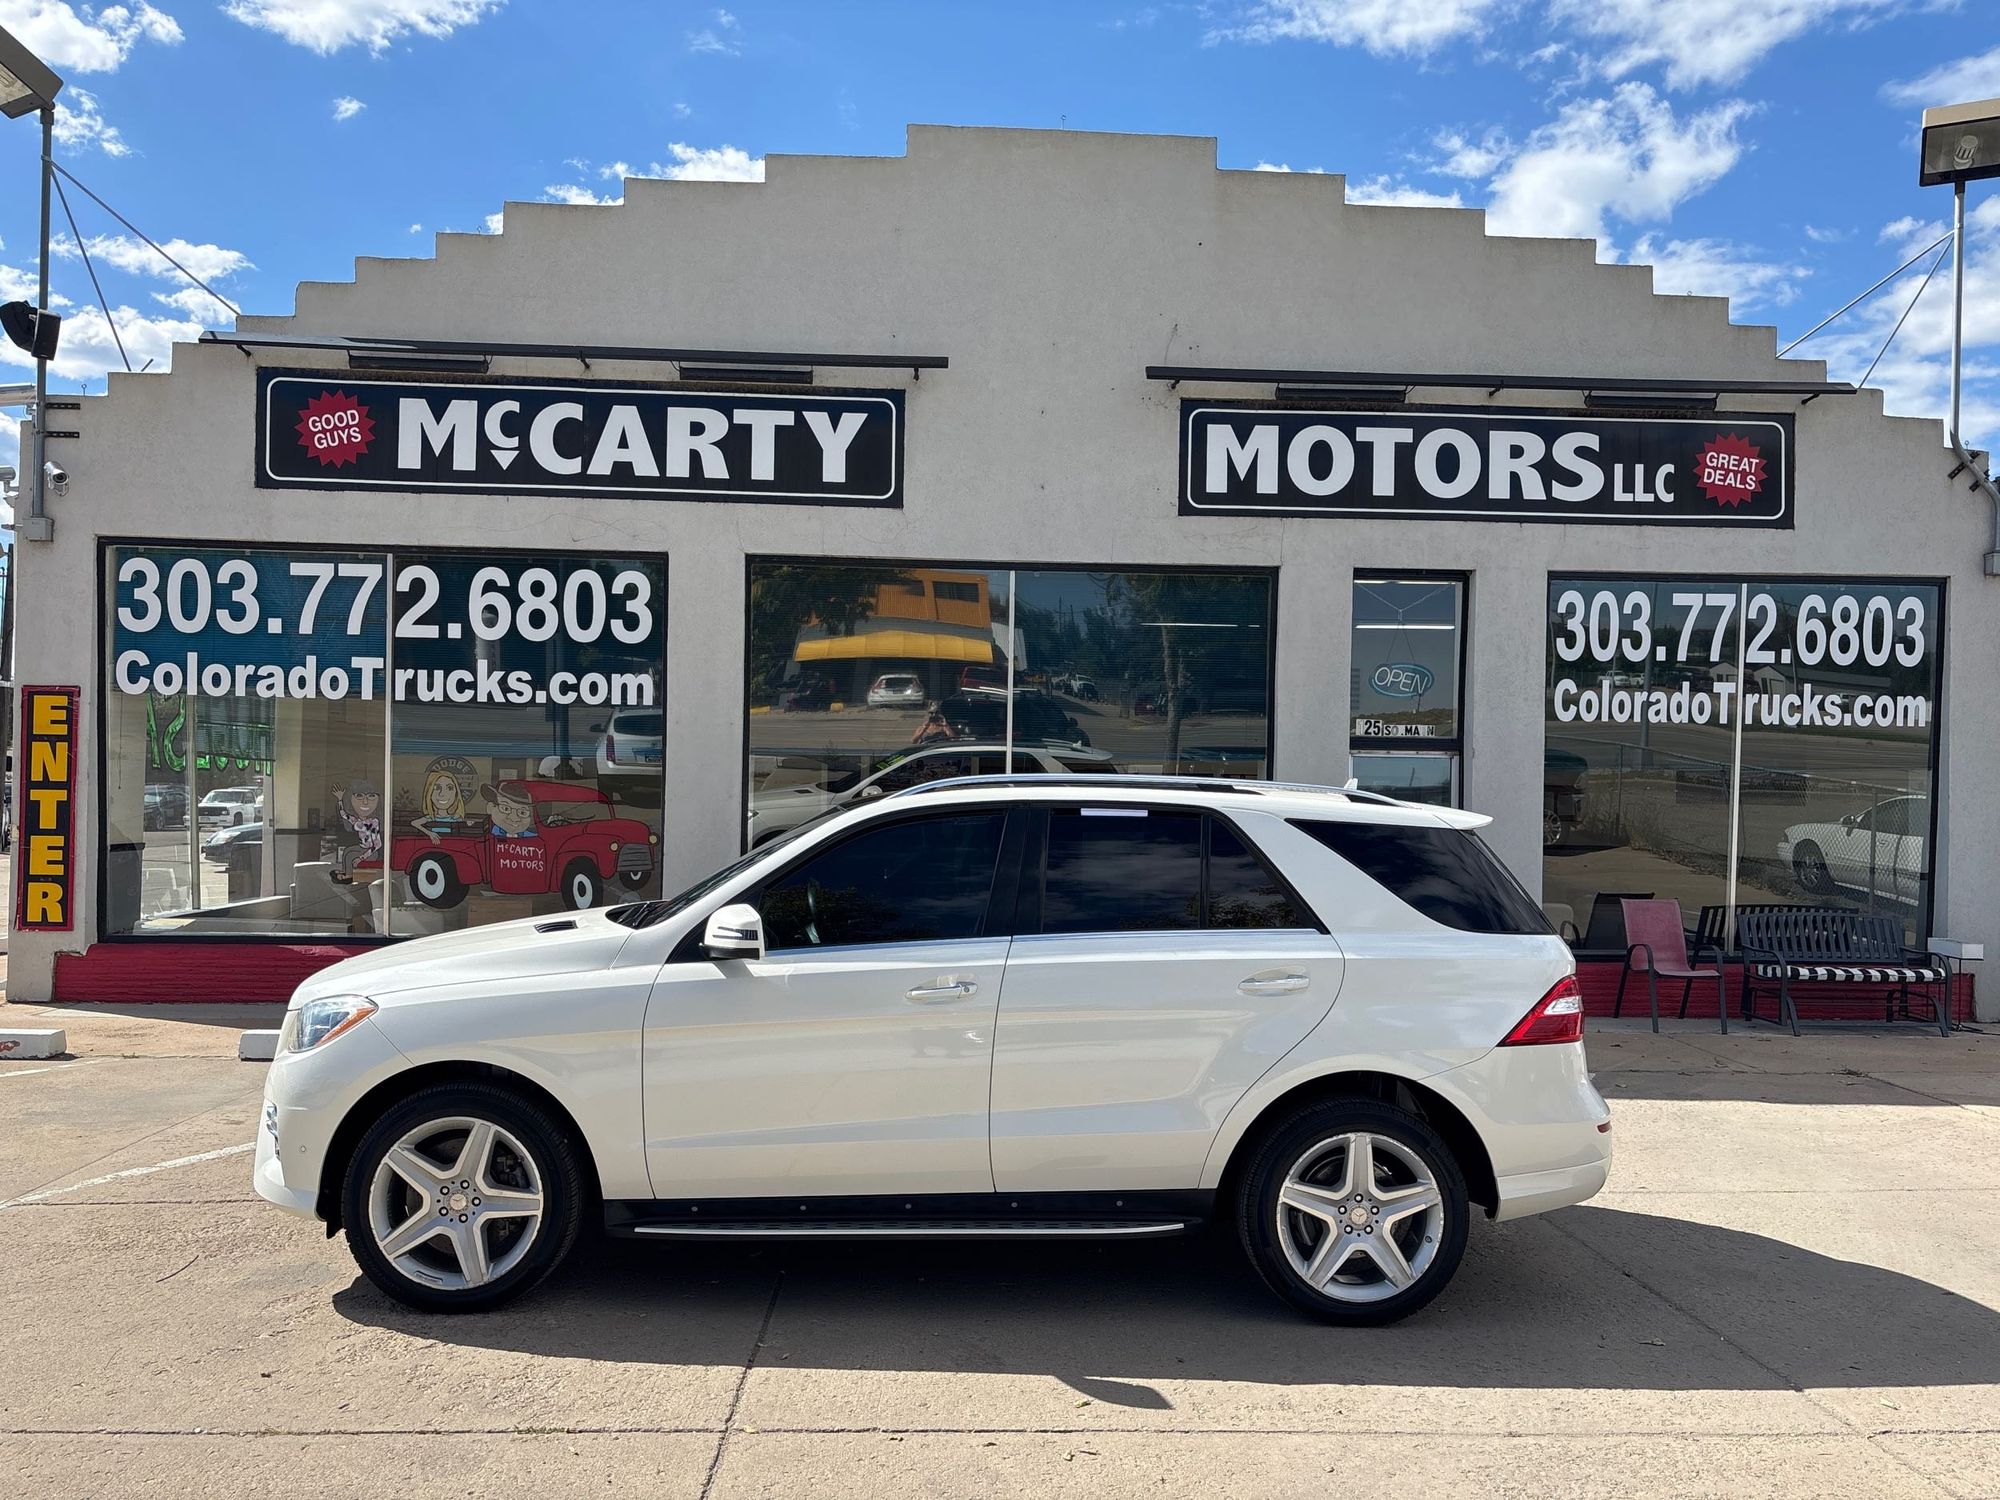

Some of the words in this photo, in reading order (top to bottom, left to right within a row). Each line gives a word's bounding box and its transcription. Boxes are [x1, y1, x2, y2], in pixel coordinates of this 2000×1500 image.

[308, 409, 359, 432] GOOD
[314, 427, 362, 449] GUYS
[398, 397, 868, 483] McCARTY
[1205, 423, 1605, 502] MOTORS
[1613, 463, 1675, 502] LLC
[1706, 451, 1760, 473] GREAT
[1703, 468, 1757, 490] DEALS
[117, 557, 653, 645] 303.772.6803
[1555, 590, 1925, 667] 303.772.6803
[115, 650, 654, 706] ColoradoTrucks.com
[1375, 666, 1428, 694] OPEN
[1553, 678, 1926, 728] ColoradoTrucks.com
[432, 759, 471, 774] DODGE
[26, 694, 69, 923] ENTER
[496, 844, 544, 859] McCARTY
[500, 858, 544, 872] MOTORS
